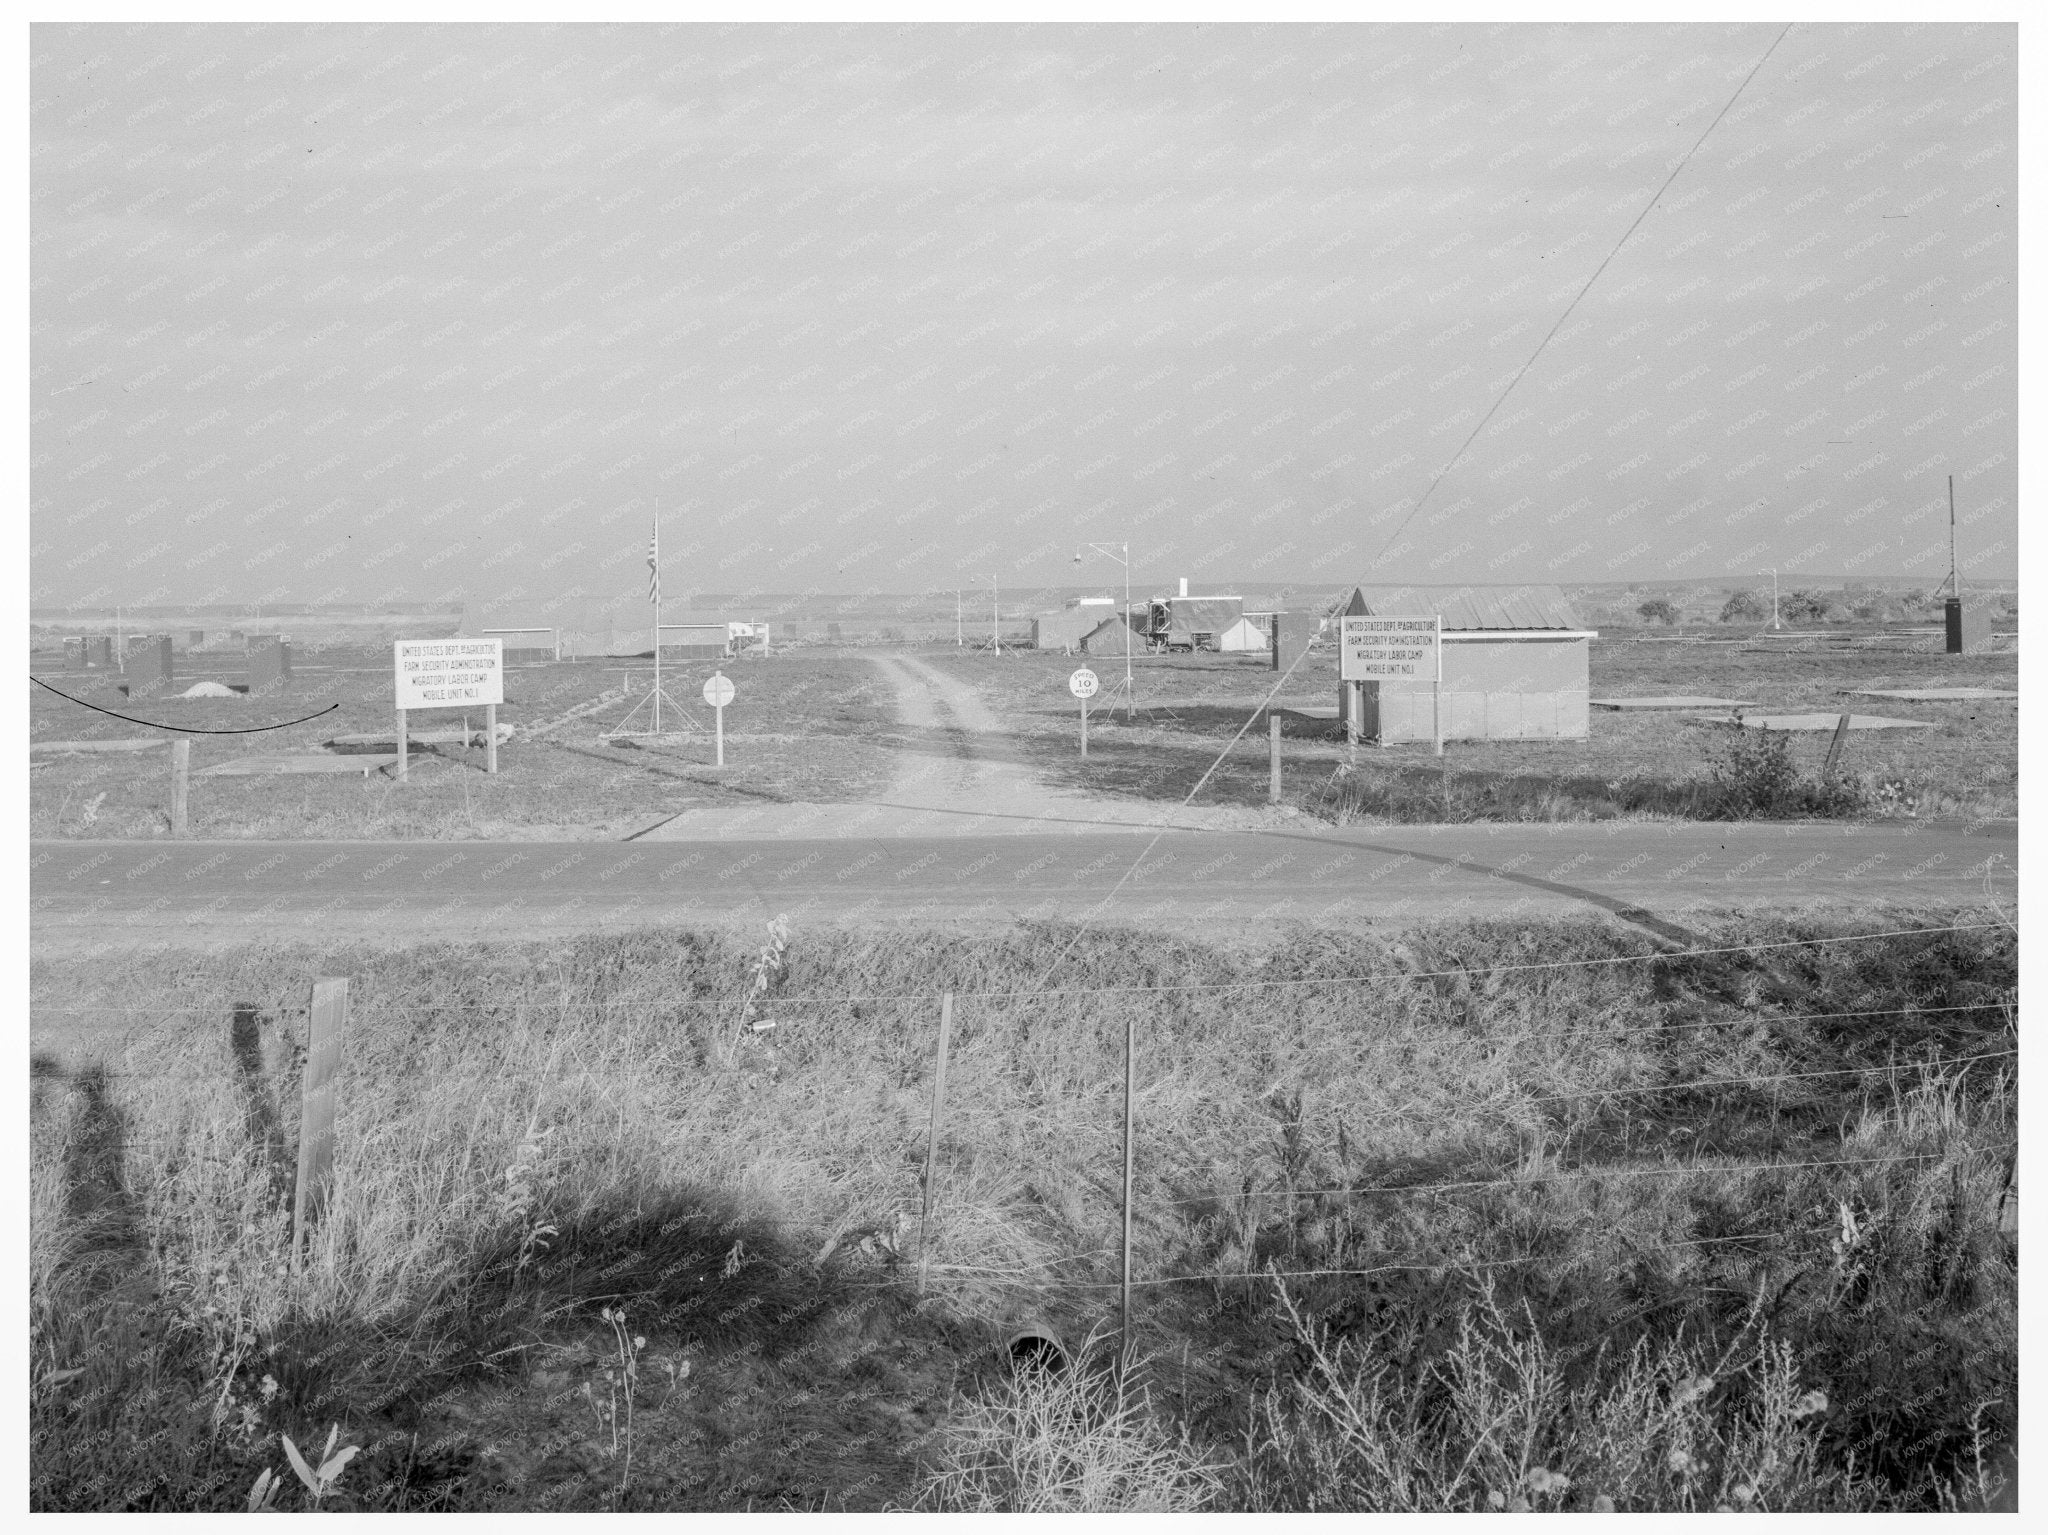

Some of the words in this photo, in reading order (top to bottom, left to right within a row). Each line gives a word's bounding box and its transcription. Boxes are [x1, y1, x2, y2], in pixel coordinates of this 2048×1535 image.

[1345, 621, 1364, 631] UNITED
[1364, 621, 1382, 631] STATES
[1383, 621, 1397, 631] DEPT.
[1402, 620, 1436, 631] AGRICULTURE
[1348, 635, 1361, 646] FARM
[1363, 635, 1388, 646] SECURITY
[1388, 635, 1433, 646] ADMINISTRATION
[402, 646, 421, 657] UNITED
[422, 646, 443, 656] STATES
[445, 645, 460, 656] DEPT.
[465, 644, 496, 655] AGRICULTURE
[1356, 650, 1387, 660] MIGRATORY
[1388, 650, 1406, 660] LABOR
[1407, 650, 1423, 660] CAMP
[404, 661, 420, 672] FARM
[422, 660, 449, 671] SECURITY
[450, 659, 496, 670] ADMINISTRATION
[1365, 664, 1385, 674] MOBILE
[1386, 664, 1400, 674] UNIT
[412, 675, 446, 686] MIGRATORY
[448, 674, 469, 685] LABOR
[470, 673, 488, 684] CAMP
[1074, 672, 1094, 680] SPEED
[422, 690, 446, 701] MOBILE
[448, 689, 462, 699] UNIT
